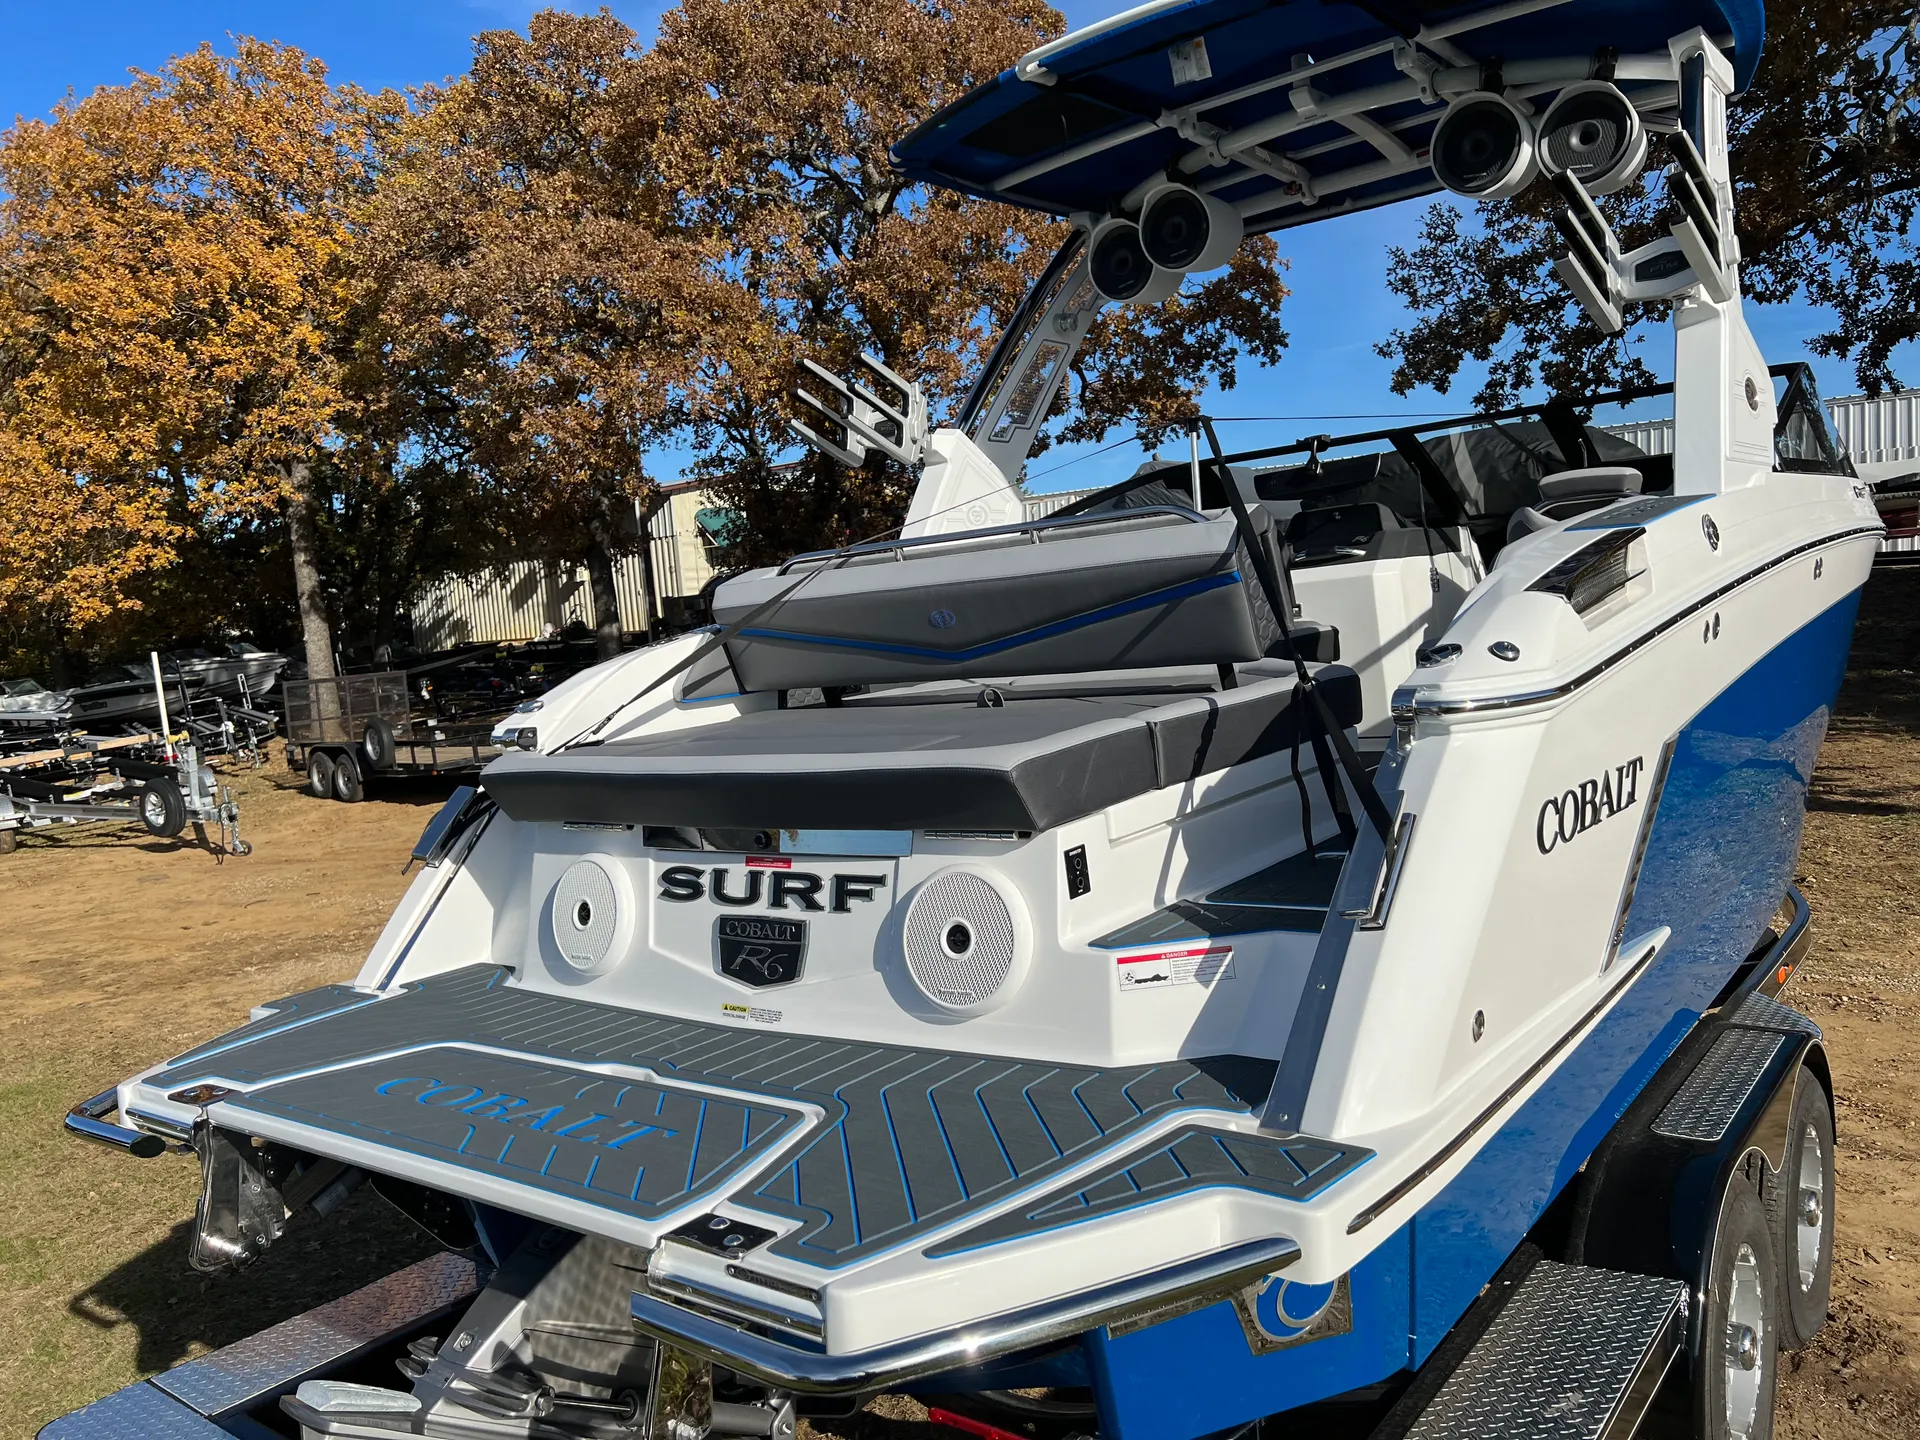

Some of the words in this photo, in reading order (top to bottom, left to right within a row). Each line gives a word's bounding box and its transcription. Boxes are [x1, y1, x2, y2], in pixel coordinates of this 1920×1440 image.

[1537, 755, 1643, 855] COBALT
[661, 865, 888, 913] SURF
[725, 919, 796, 941] COBALT
[729, 945, 788, 980] R6
[374, 1077, 679, 1150] COBALT
